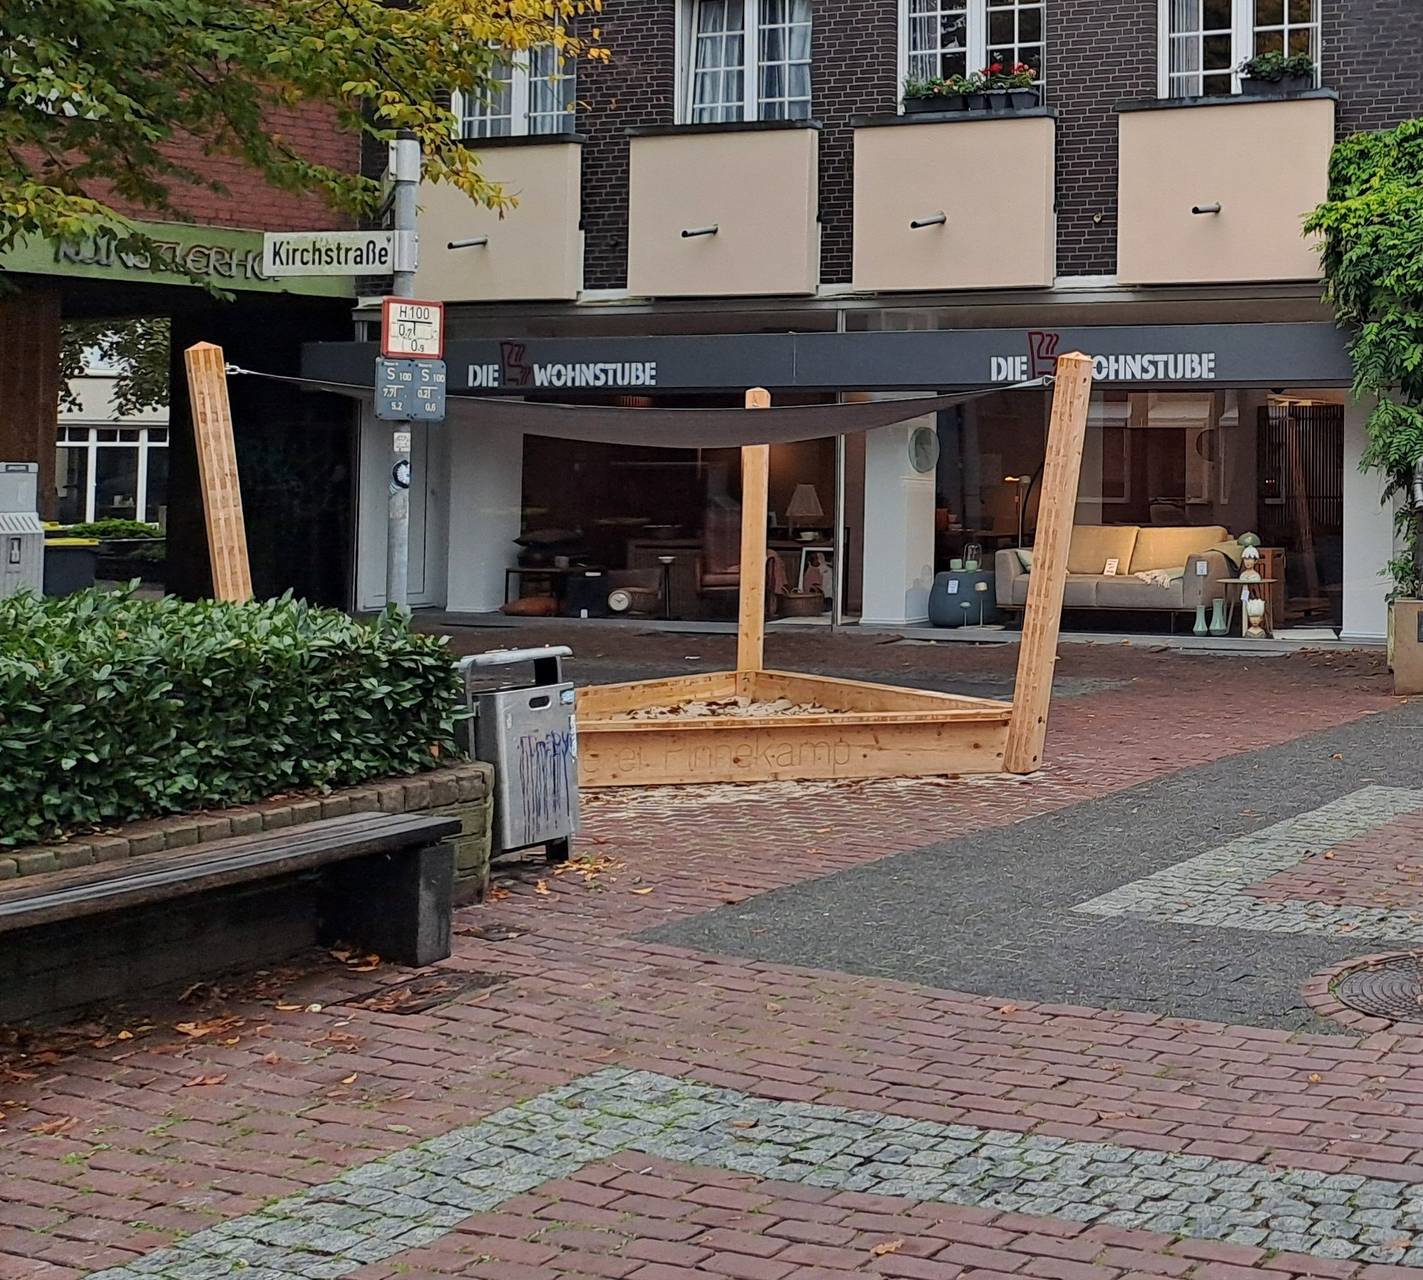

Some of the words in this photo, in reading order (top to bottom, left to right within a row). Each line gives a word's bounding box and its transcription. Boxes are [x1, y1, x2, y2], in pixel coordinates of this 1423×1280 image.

[272, 240, 389, 266] Kirchstraße
[467, 364, 499, 387] DIE
[533, 362, 656, 387] WOHNSTUBE
[990, 356, 1028, 381] DIE
[1088, 353, 1216, 380] OHNSTUBE
